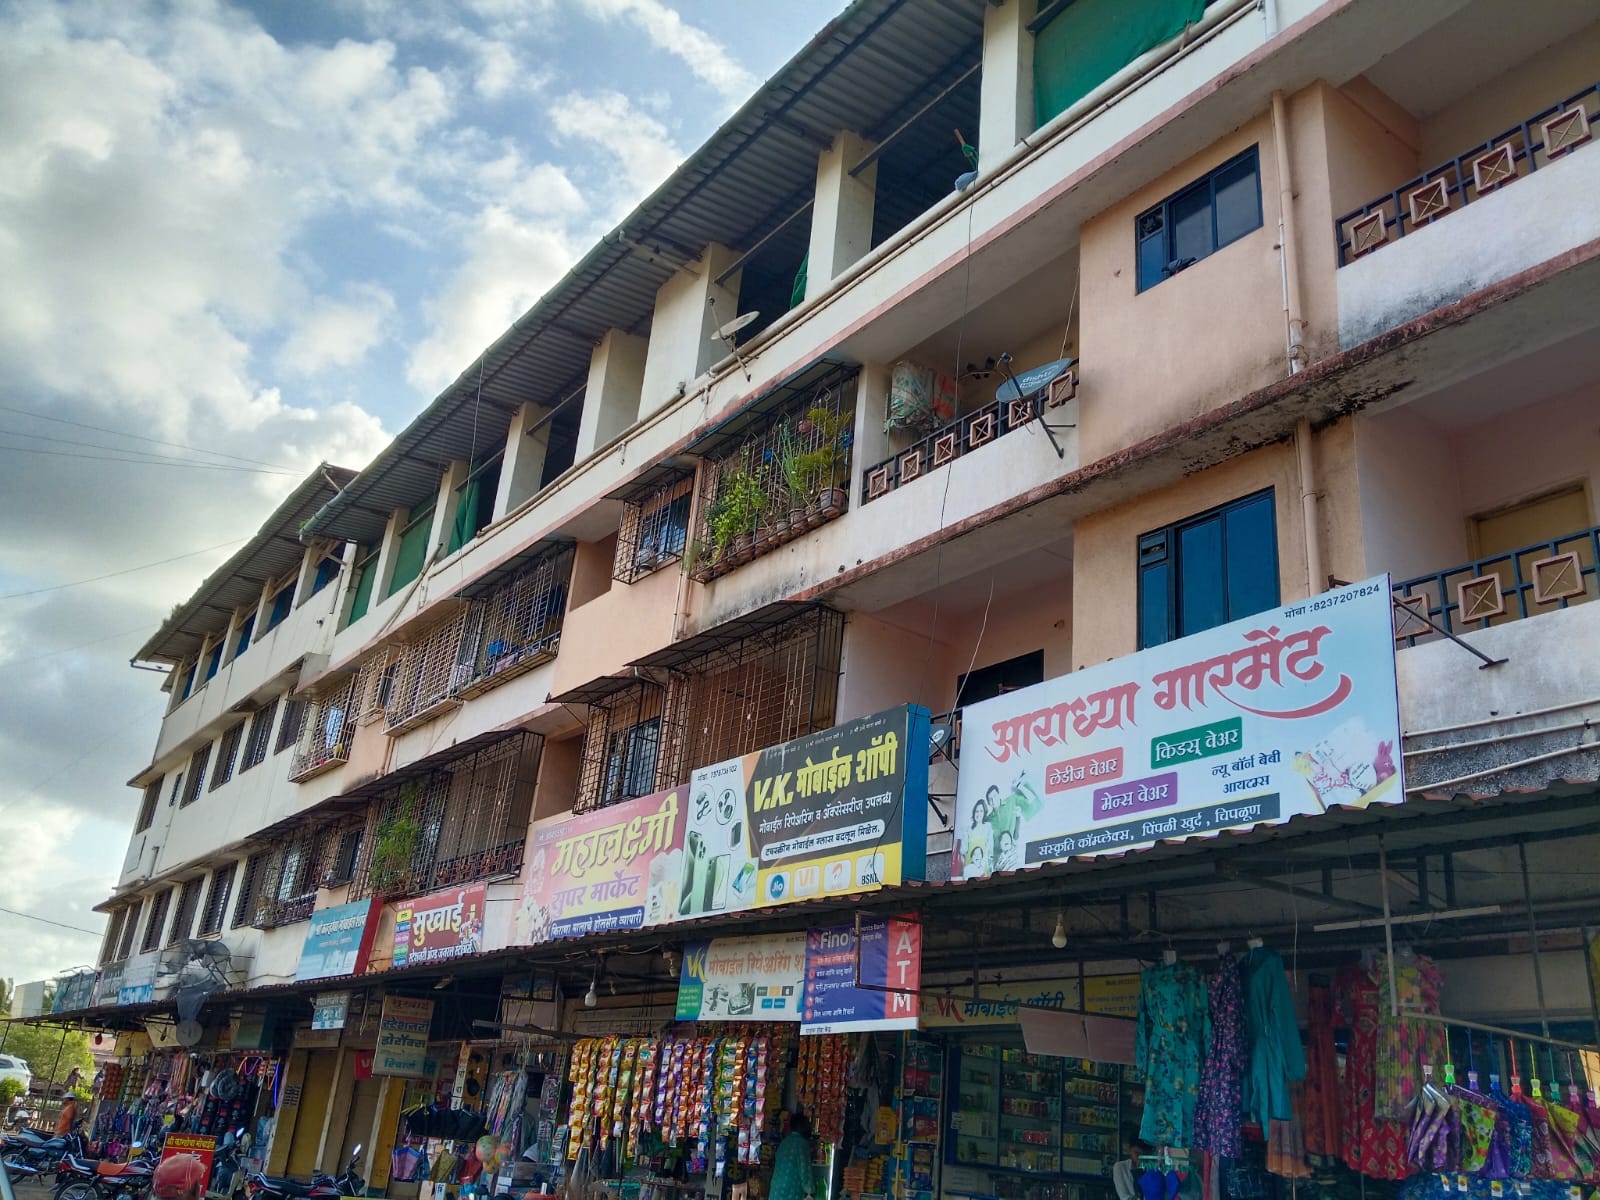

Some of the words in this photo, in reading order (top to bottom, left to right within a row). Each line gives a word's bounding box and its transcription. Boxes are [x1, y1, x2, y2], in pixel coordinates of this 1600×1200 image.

[1285, 606, 1306, 619] मोबा
[985, 681, 1141, 763] आराध्या
[1153, 625, 1352, 719] गारमेंट
[1205, 728, 1239, 749] वेअर
[753, 771, 795, 813] V.K.
[796, 746, 853, 799] मोबाईल
[856, 731, 898, 783] शॉपी
[1050, 765, 1085, 786] लेडीज
[1089, 759, 1118, 776] वेअर
[1212, 764, 1230, 778] न्यू
[1232, 755, 1255, 772] बॉर्न
[1259, 750, 1281, 766] बेबी
[1101, 789, 1134, 812] मेन्स
[1138, 784, 1169, 801] वेअर
[1223, 775, 1270, 794] आयटम्स
[759, 815, 783, 834] मोबाईल
[865, 791, 893, 809] उपलब्ध
[551, 792, 679, 878] महालक्ष्मी
[792, 837, 815, 851] मोबाईल
[835, 829, 856, 841] बदलून
[1039, 838, 1075, 857] संस्कृति
[1142, 818, 1177, 837] पिंपळी
[1215, 803, 1261, 823] चिपळूण
[552, 885, 587, 917] सुपर
[591, 870, 641, 903] मार्केट
[772, 880, 784, 893] Jio
[413, 891, 466, 947] सुखाई
[551, 921, 572, 938] किराणा
[594, 914, 618, 930] होलसेल
[619, 909, 643, 926] व्यापारी
[708, 953, 744, 977] मोबाईल
